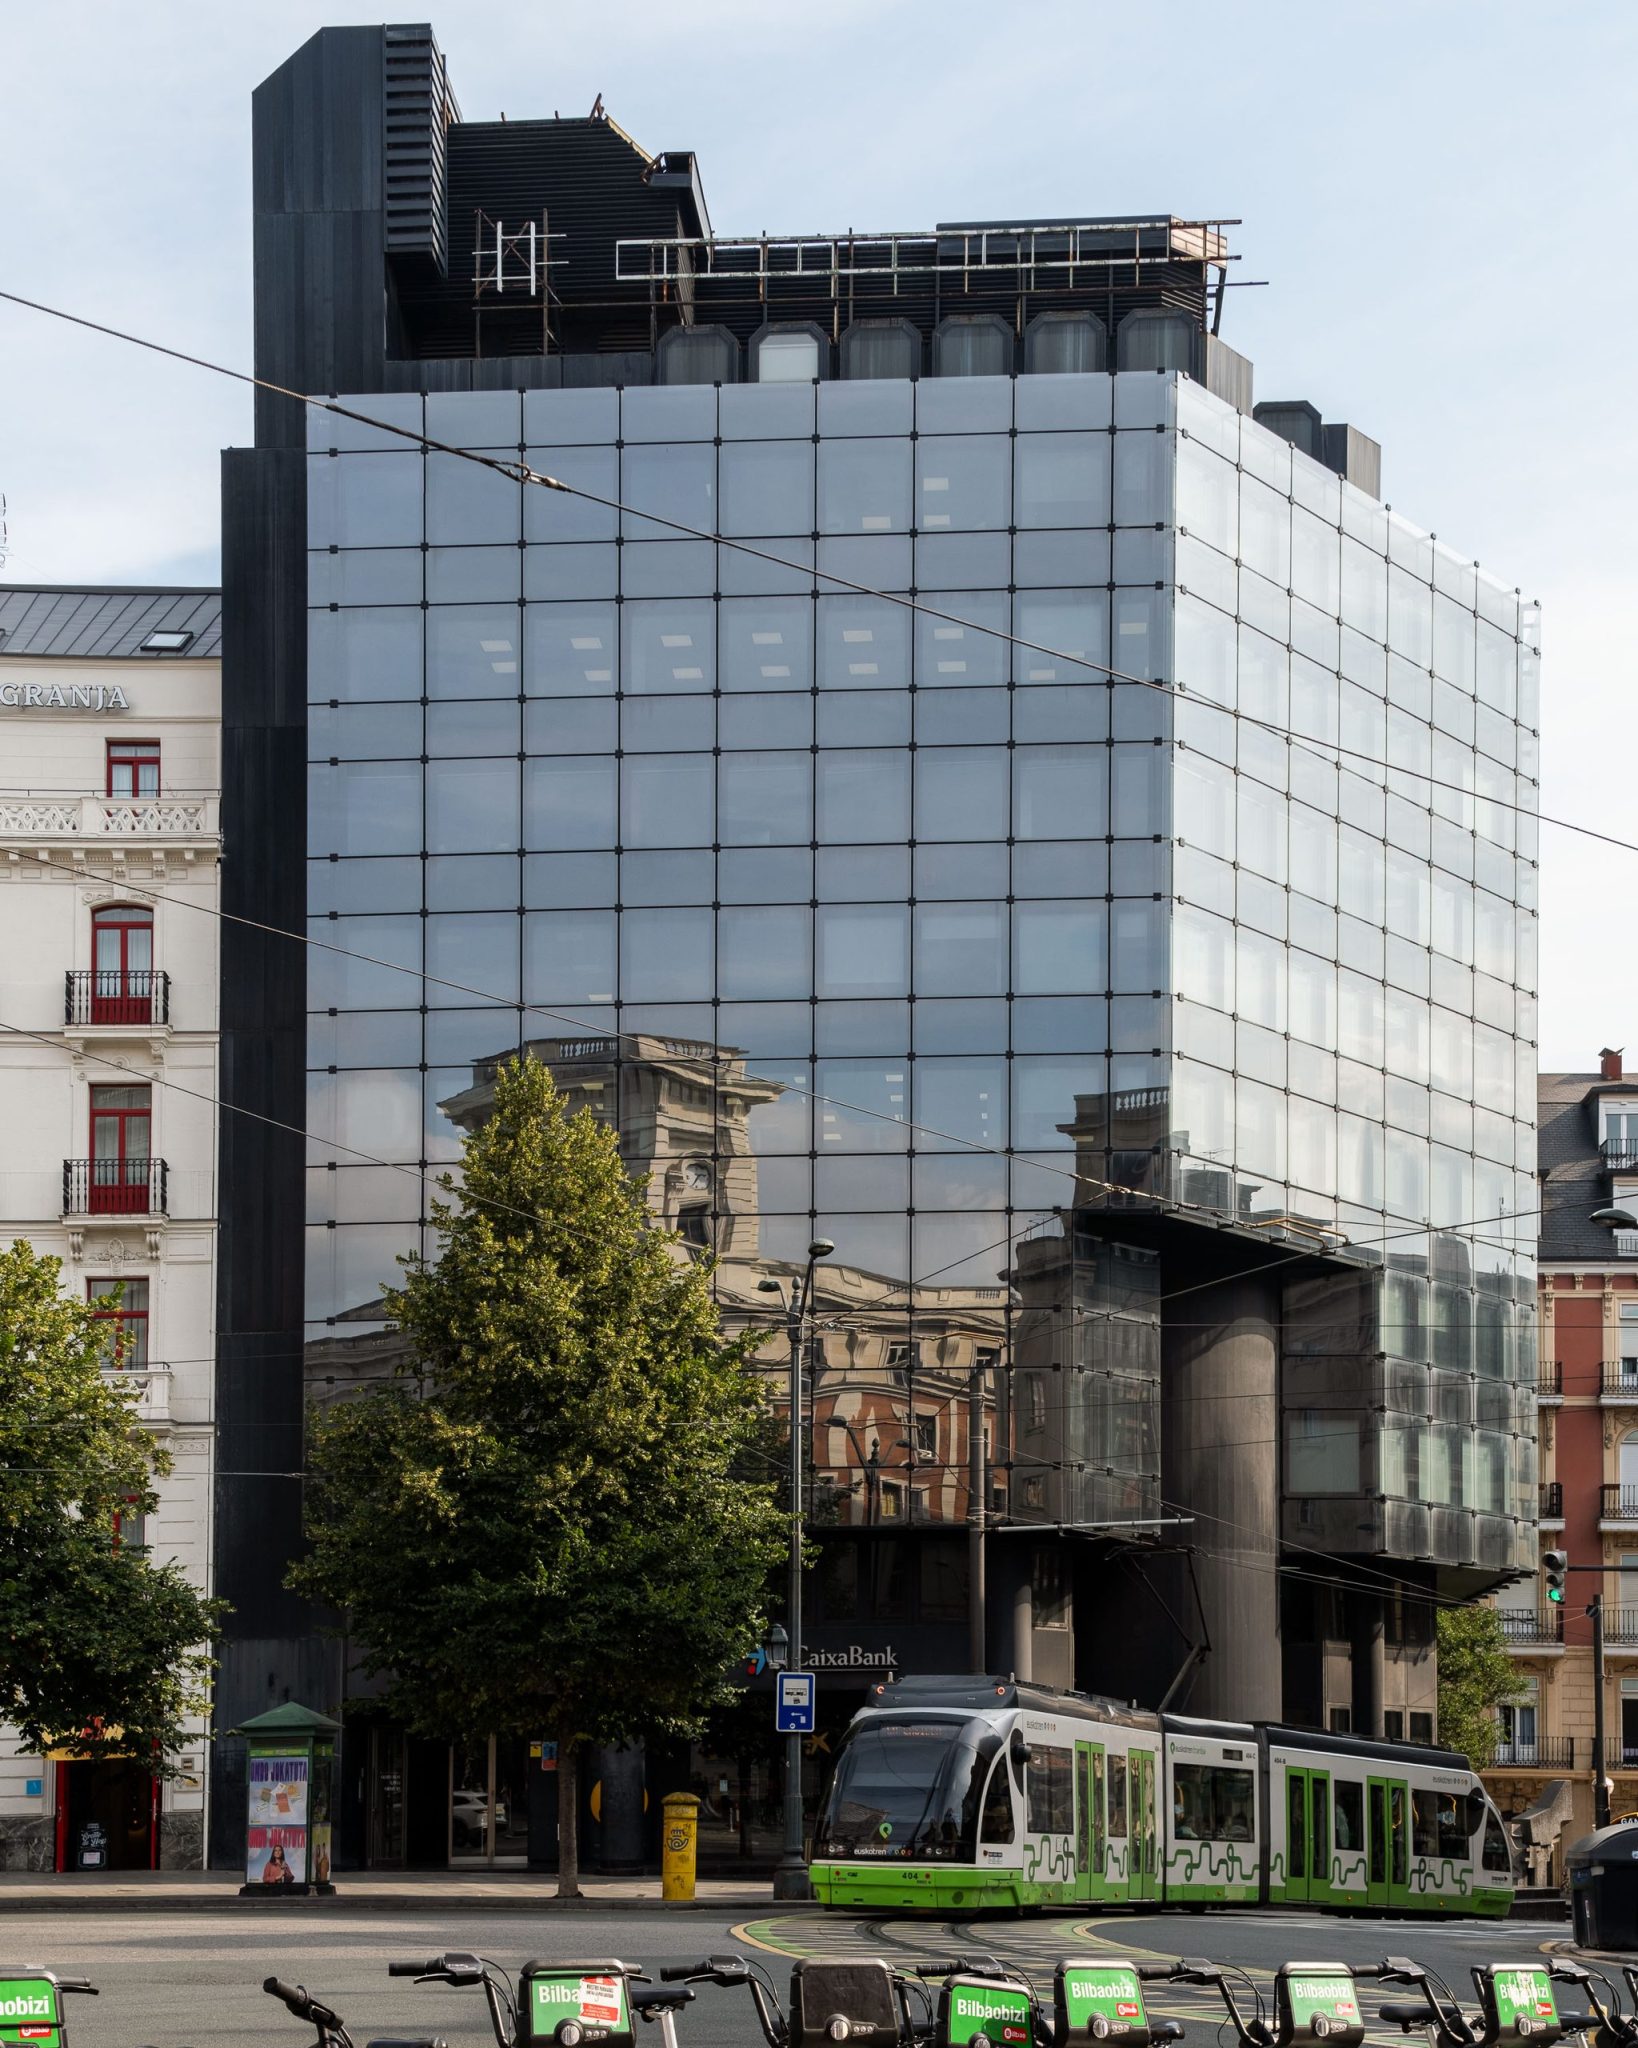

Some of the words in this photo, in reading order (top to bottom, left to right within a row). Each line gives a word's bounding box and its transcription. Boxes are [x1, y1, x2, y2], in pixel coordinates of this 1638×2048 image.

[0, 683, 129, 712] GRANJA
[800, 1645, 898, 1667] CaixaBank
[901, 1871, 918, 1880] 404
[1070, 1981, 1136, 1999] Bilbaobizi
[1295, 1982, 1352, 1999] Bilbaobizi
[1499, 1982, 1550, 1999] Biizi
[957, 1998, 1026, 2024] Bilbaobizi
